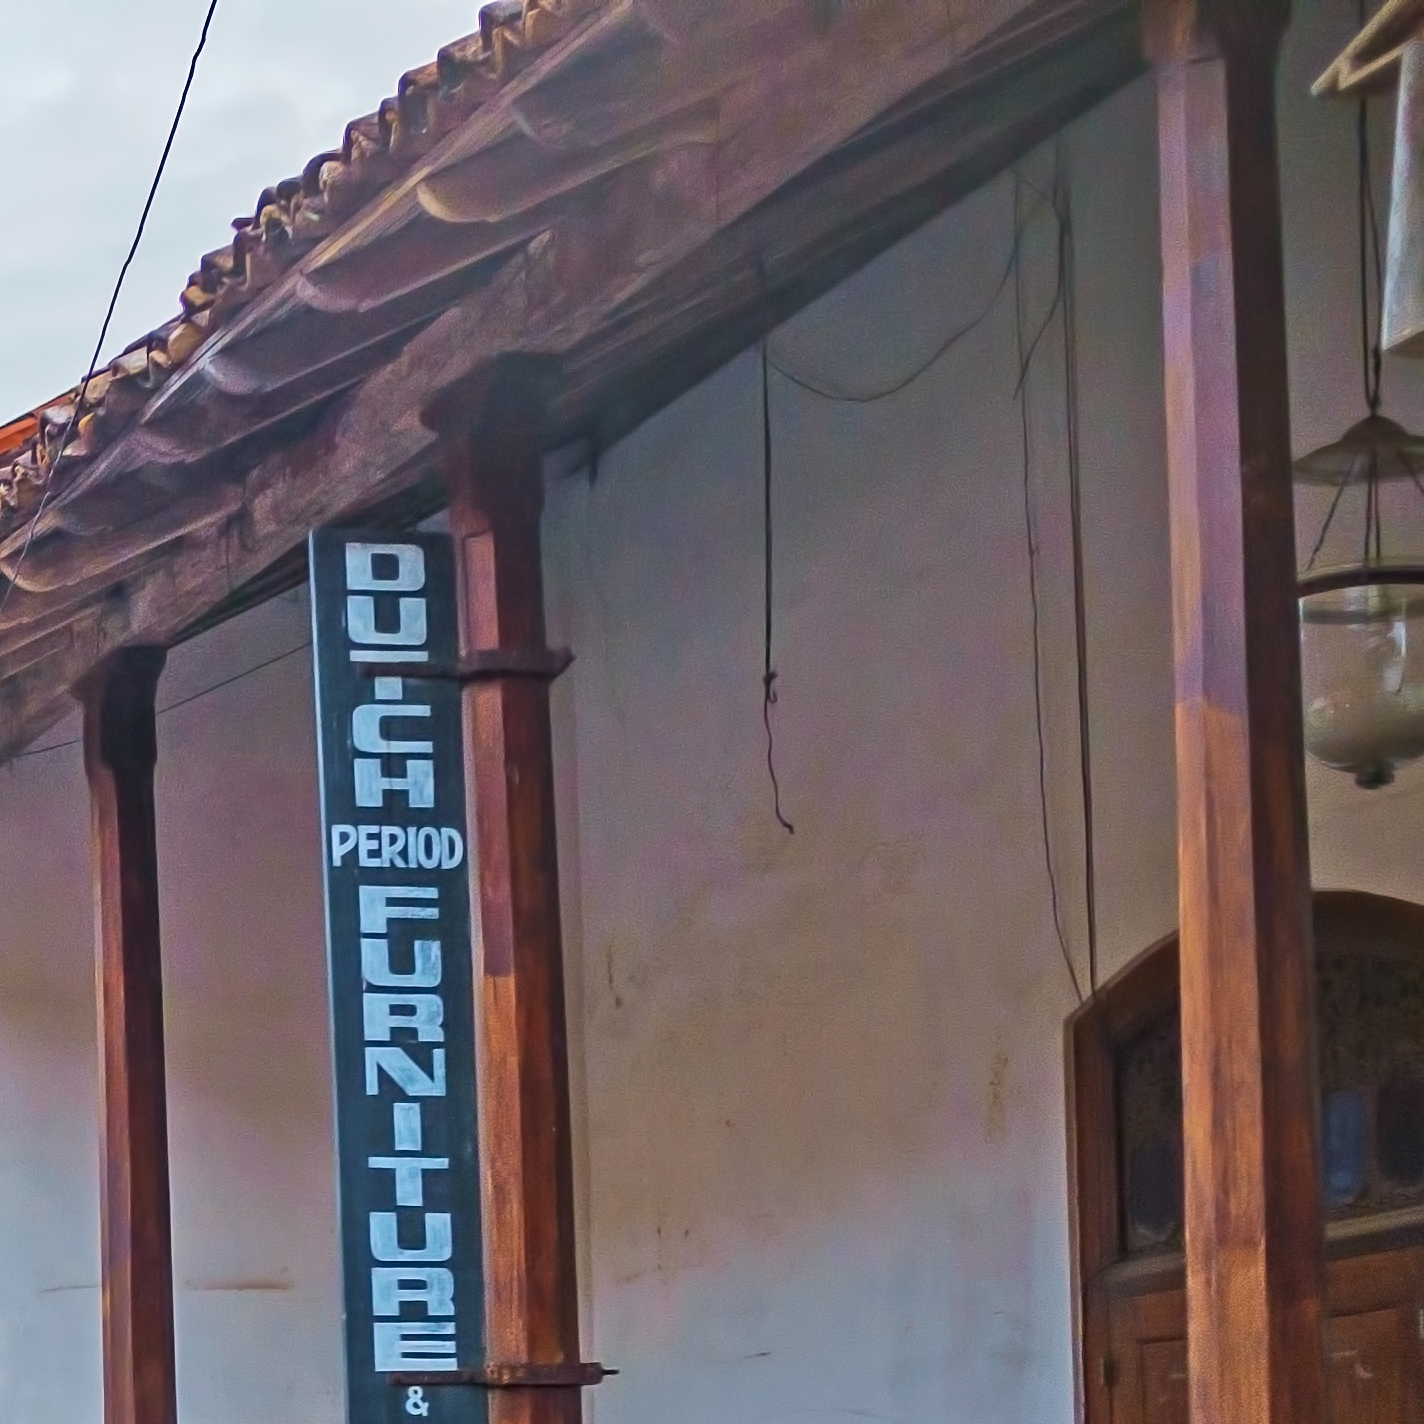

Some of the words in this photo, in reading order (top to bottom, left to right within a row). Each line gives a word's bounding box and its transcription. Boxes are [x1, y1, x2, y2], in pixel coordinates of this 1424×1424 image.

[345, 542, 435, 808] DUTCH
[332, 824, 464, 870] PERIOD
[358, 885, 458, 1373] FURNITURE
[405, 1385, 429, 1417] &
